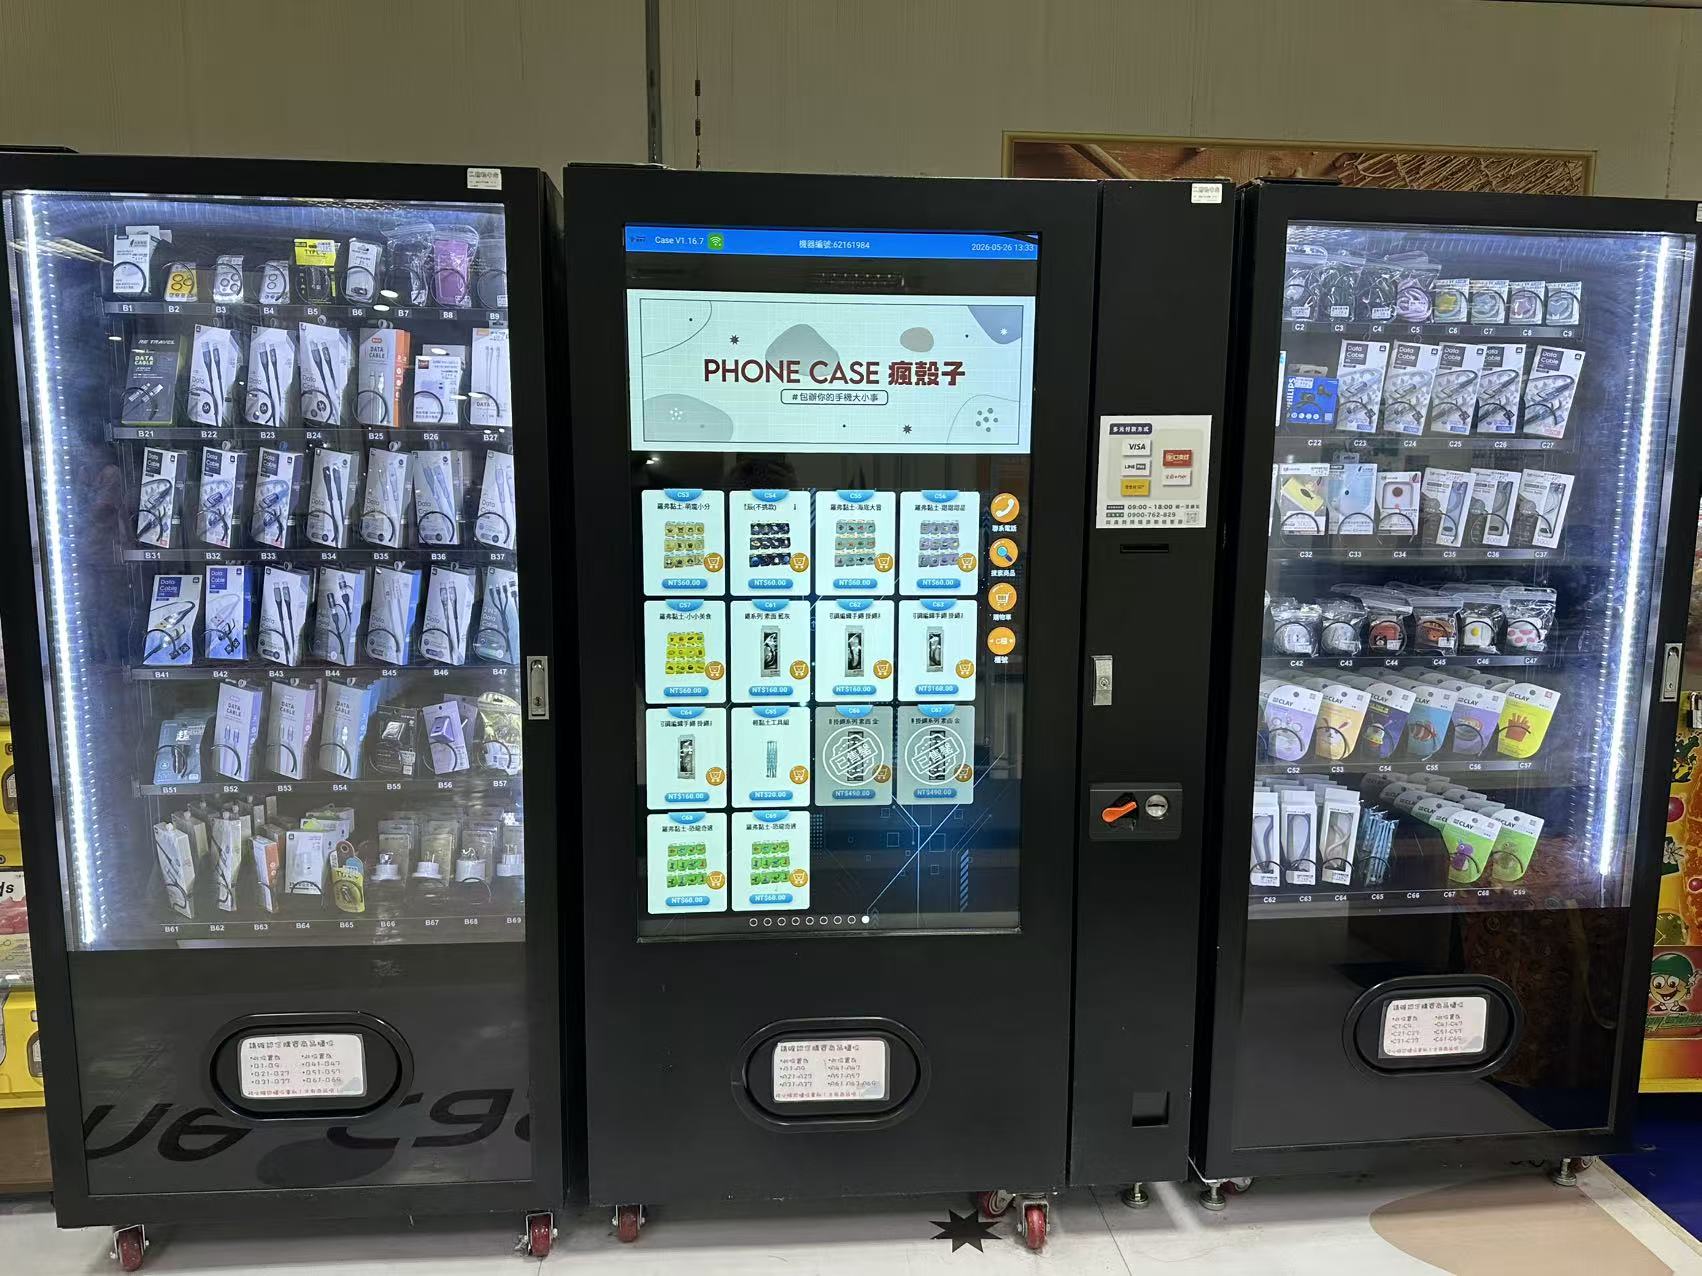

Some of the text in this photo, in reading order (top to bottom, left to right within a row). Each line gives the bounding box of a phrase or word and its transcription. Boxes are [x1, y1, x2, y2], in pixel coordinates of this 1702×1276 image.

[655, 236, 704, 245] Case V1.16.7
[799, 239, 870, 249] 機器編號:62161984
[971, 243, 1034, 252] 2026-05-26 13:33
[704, 358, 966, 386] PHONE CASE 瘋殼子
[138, 430, 154, 438] B21
[260, 431, 276, 439] B23
[368, 432, 384, 440] B25
[206, 552, 221, 560] B32
[1373, 694, 1388, 702] CLAY
[1415, 697, 1430, 705] CLAY
[1463, 698, 1479, 706] CLAY
[1278, 699, 1294, 707] CLAY
[1458, 820, 1474, 830] CLAY
[210, 924, 225, 932] B62
